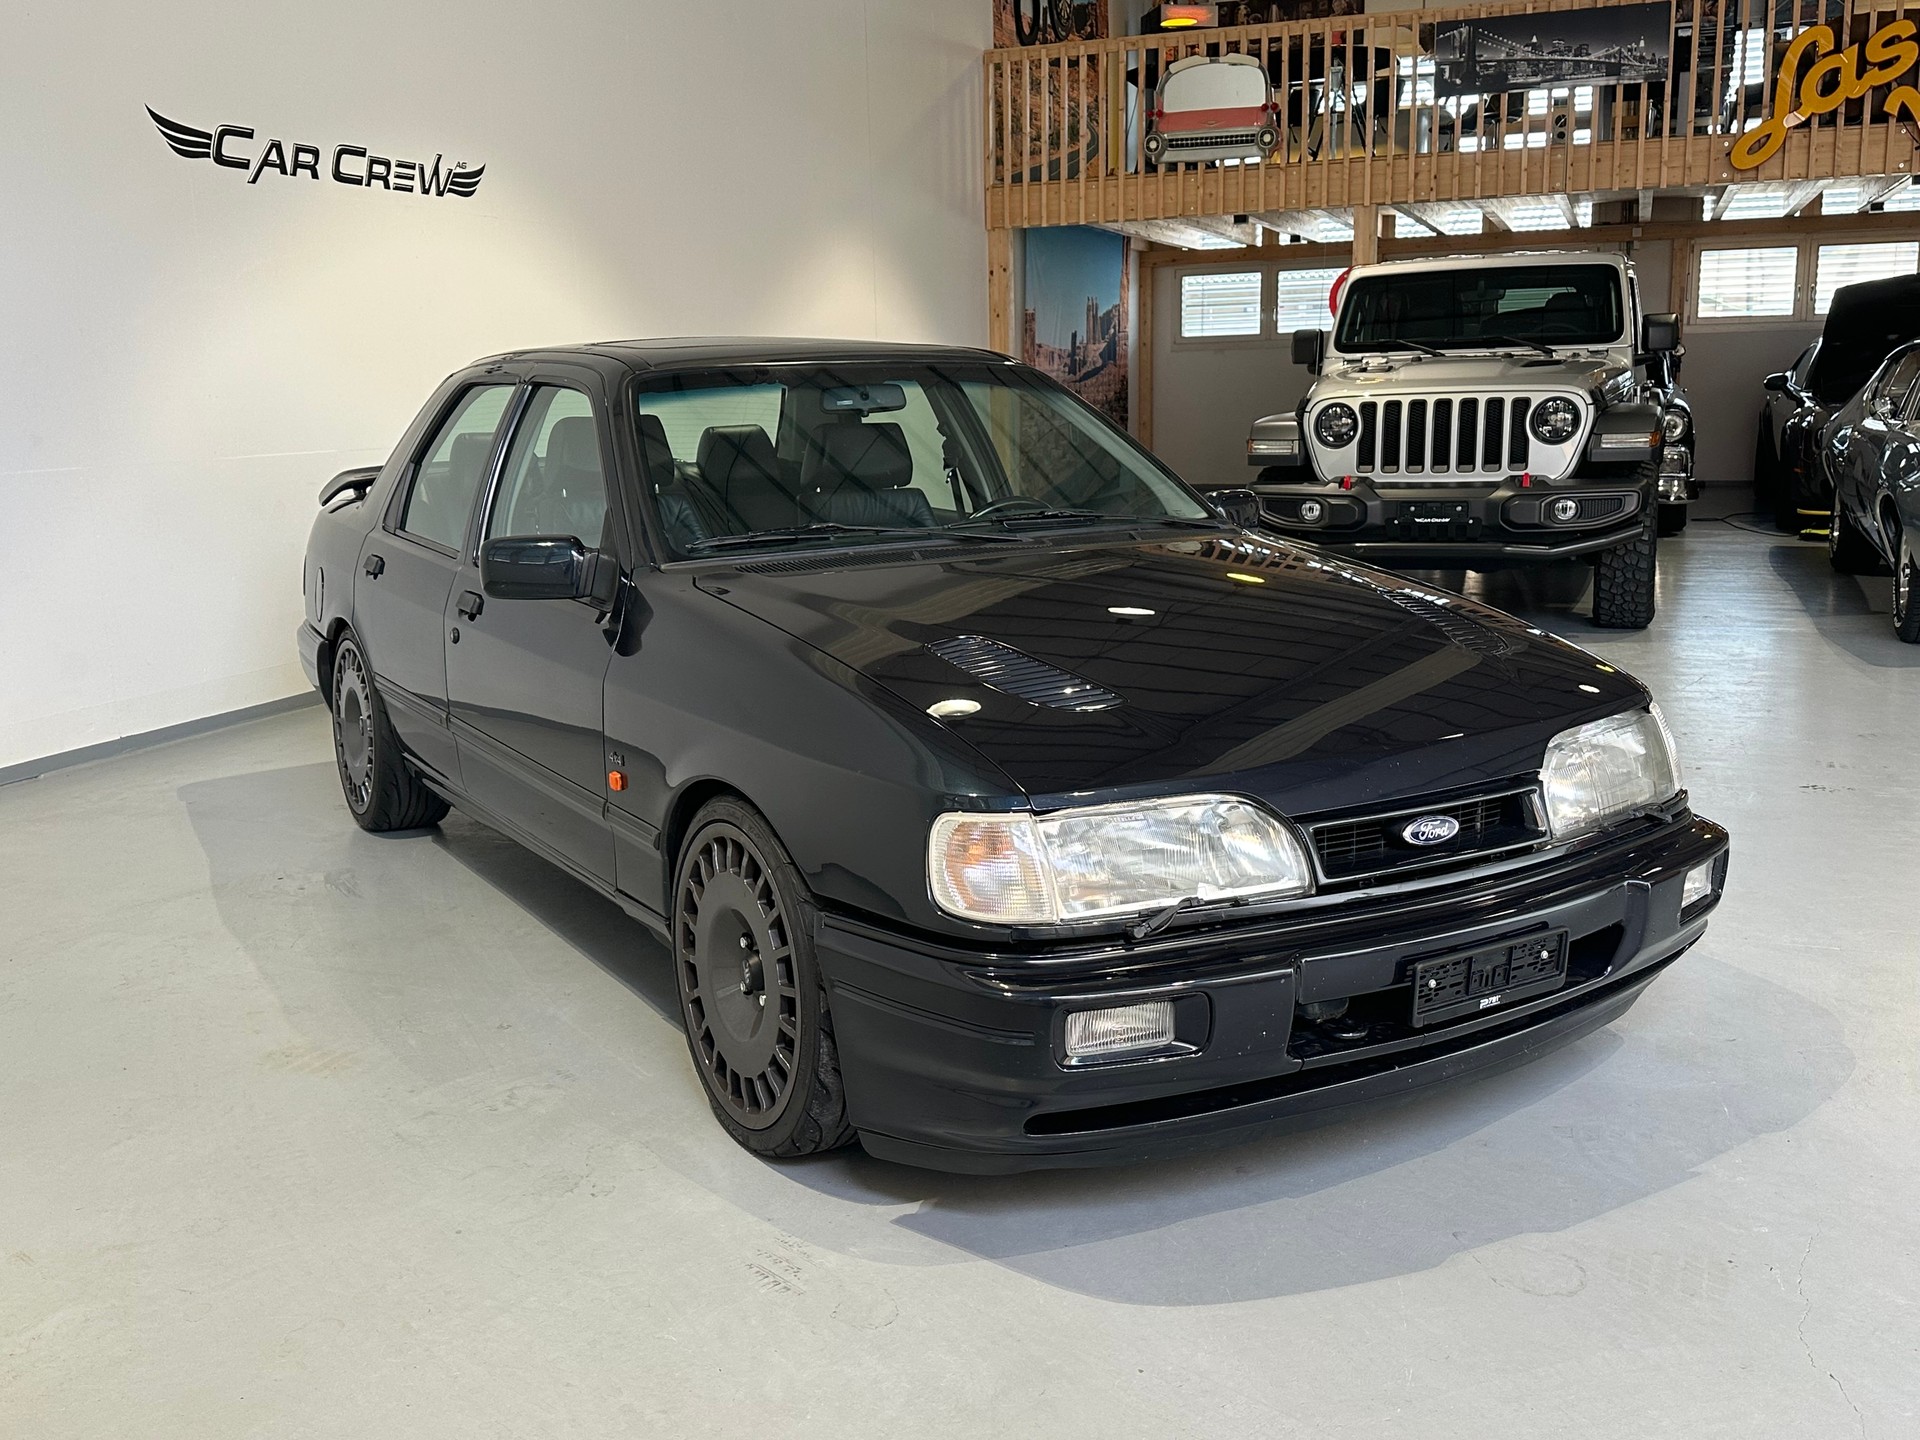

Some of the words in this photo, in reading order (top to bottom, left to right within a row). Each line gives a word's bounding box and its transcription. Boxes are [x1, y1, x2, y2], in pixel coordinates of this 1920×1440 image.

[212, 124, 320, 184] CAR
[331, 144, 454, 197] CREW
[1418, 820, 1450, 841] Ford
